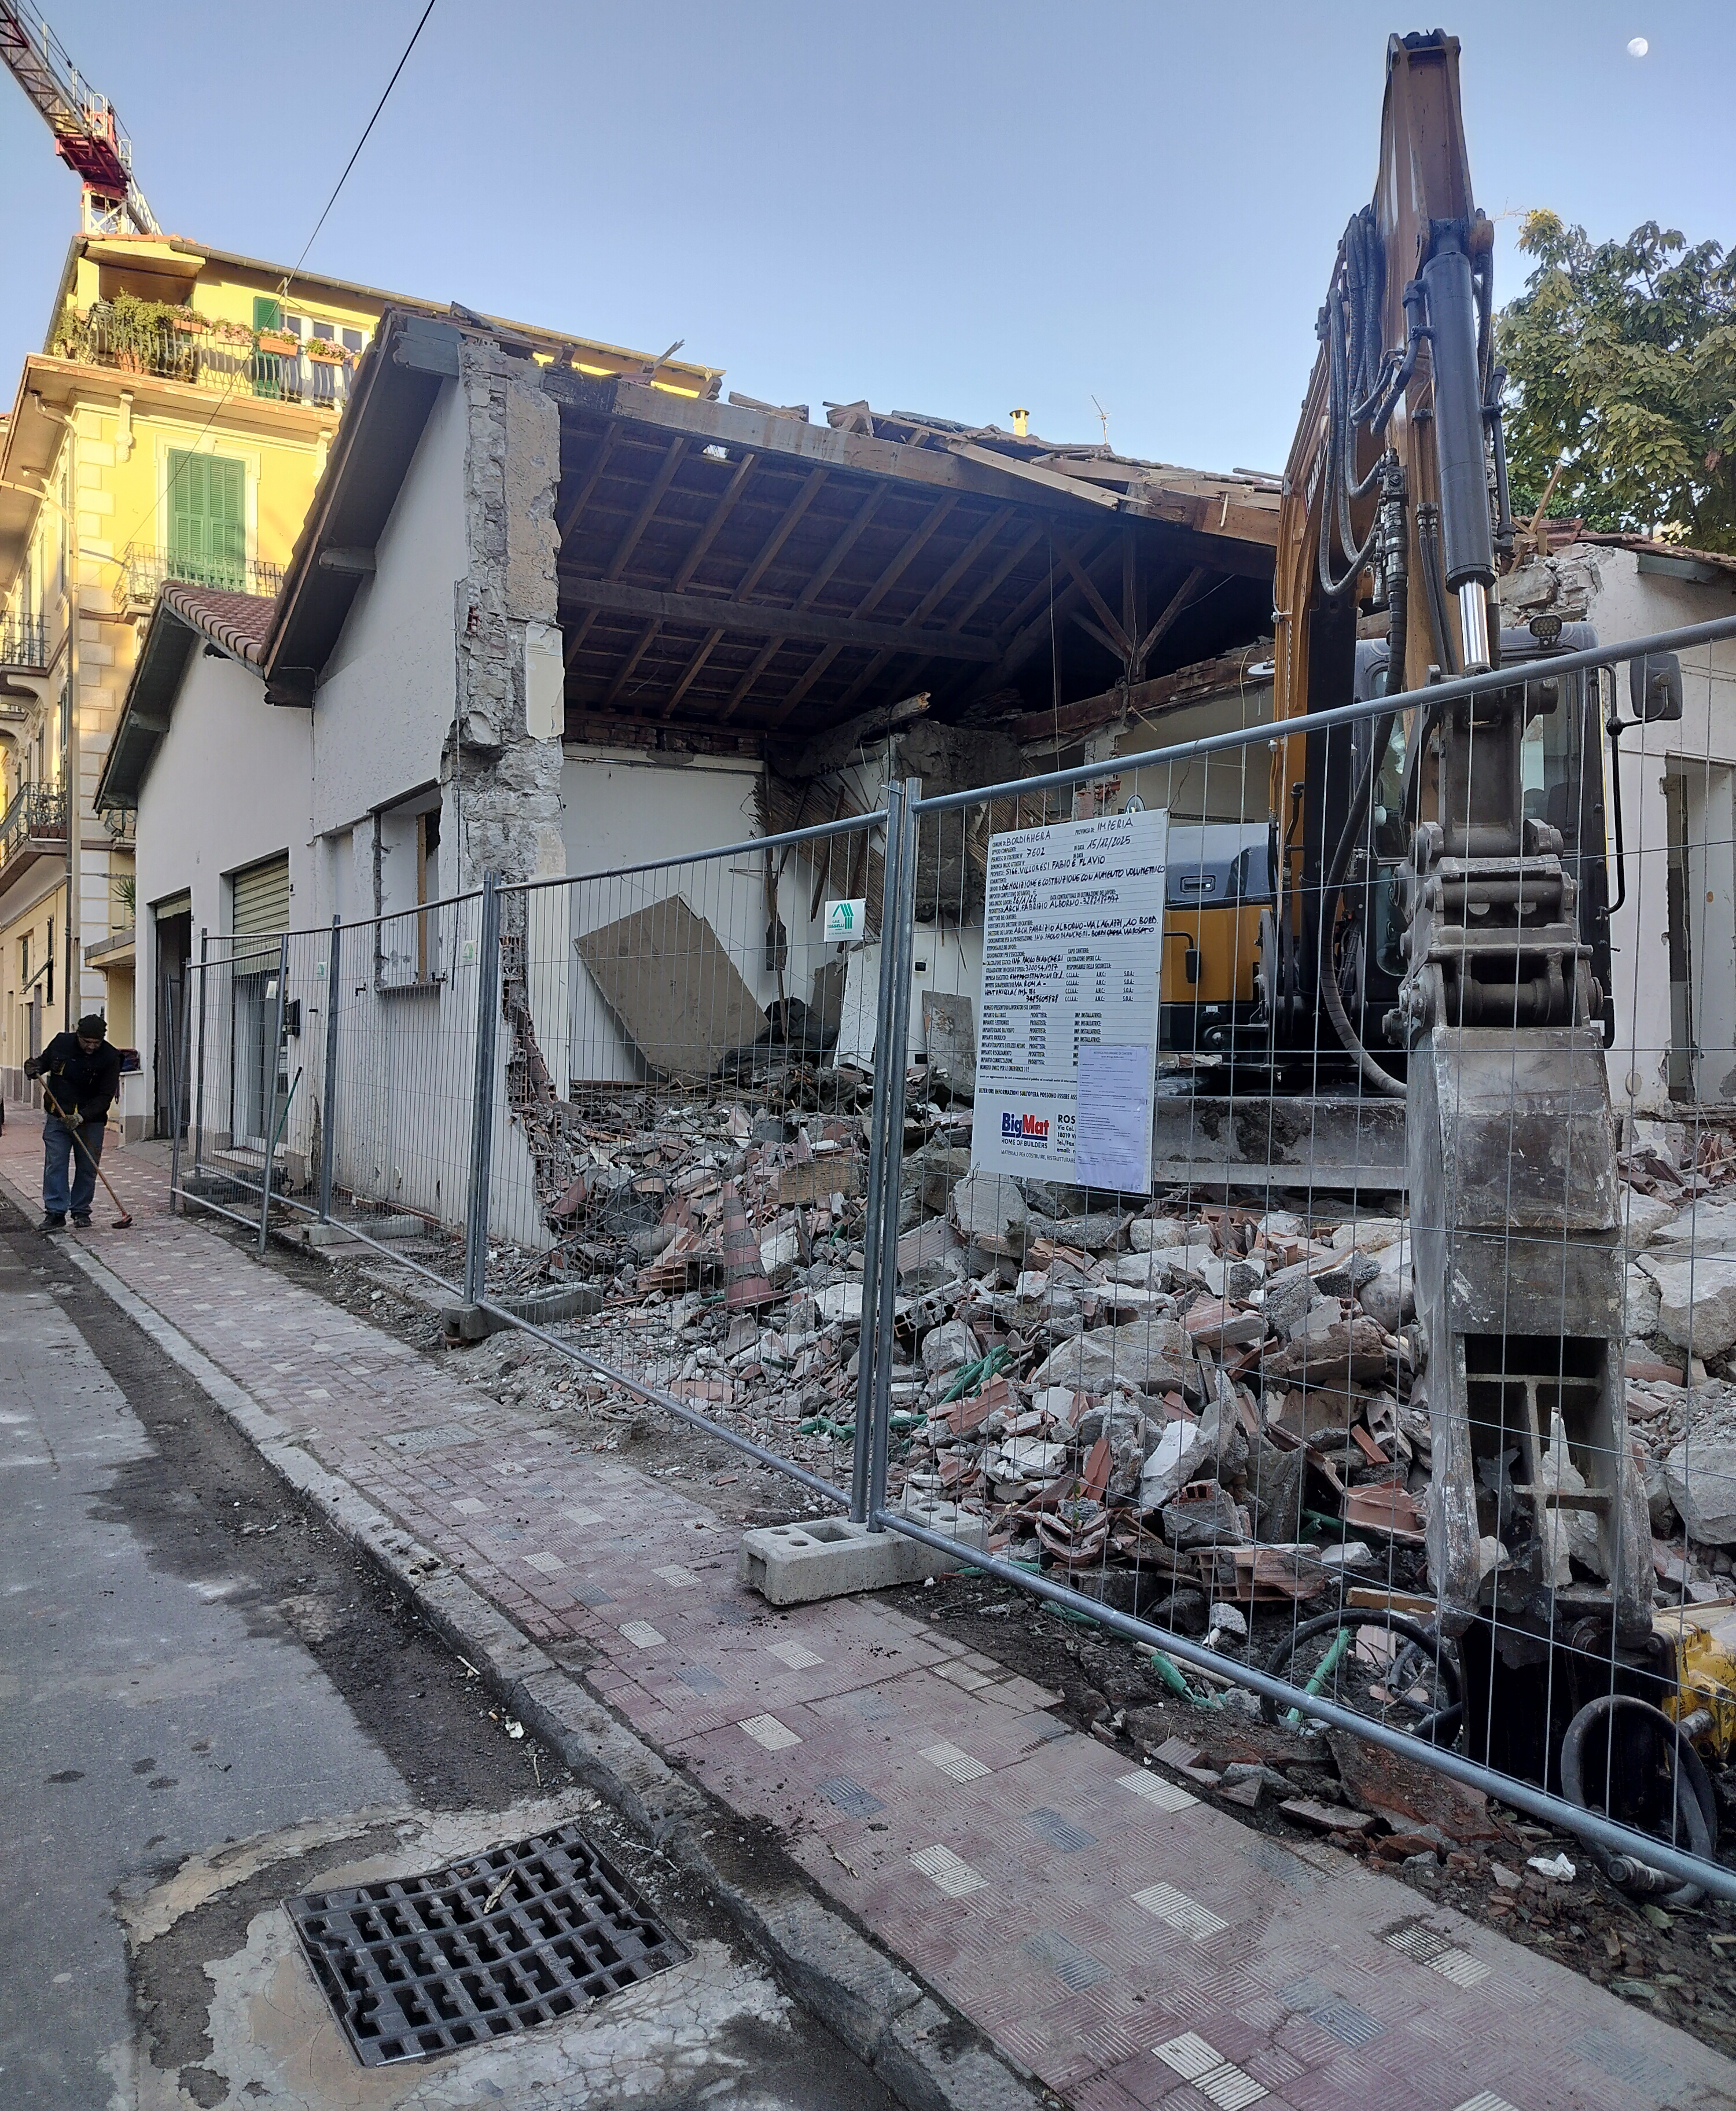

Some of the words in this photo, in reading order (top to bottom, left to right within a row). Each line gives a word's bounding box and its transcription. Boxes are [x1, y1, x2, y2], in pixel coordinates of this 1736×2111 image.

[1097, 817, 1133, 831] IMPERIA
[1006, 830, 1051, 846] BORDIGHERA
[1087, 836, 1131, 850] 15/12/2025
[1027, 847, 1045, 858] 7602
[1052, 860, 1071, 869] FABIO
[1072, 859, 1076, 867] E
[1079, 856, 1105, 866] FLAVIO
[1002, 880, 1037, 891] DEMOLIZIONE
[1042, 873, 1080, 886] COSTRUZIONE
[1094, 869, 1124, 881] AUMENTO
[1021, 902, 1047, 911] FABRIZIO
[1029, 924, 1054, 933] FABRIZIO
[1139, 915, 1158, 924] BORD.
[1002, 1112, 1049, 1138] BigMat
[1024, 1140, 1047, 1148] BUILDERS
